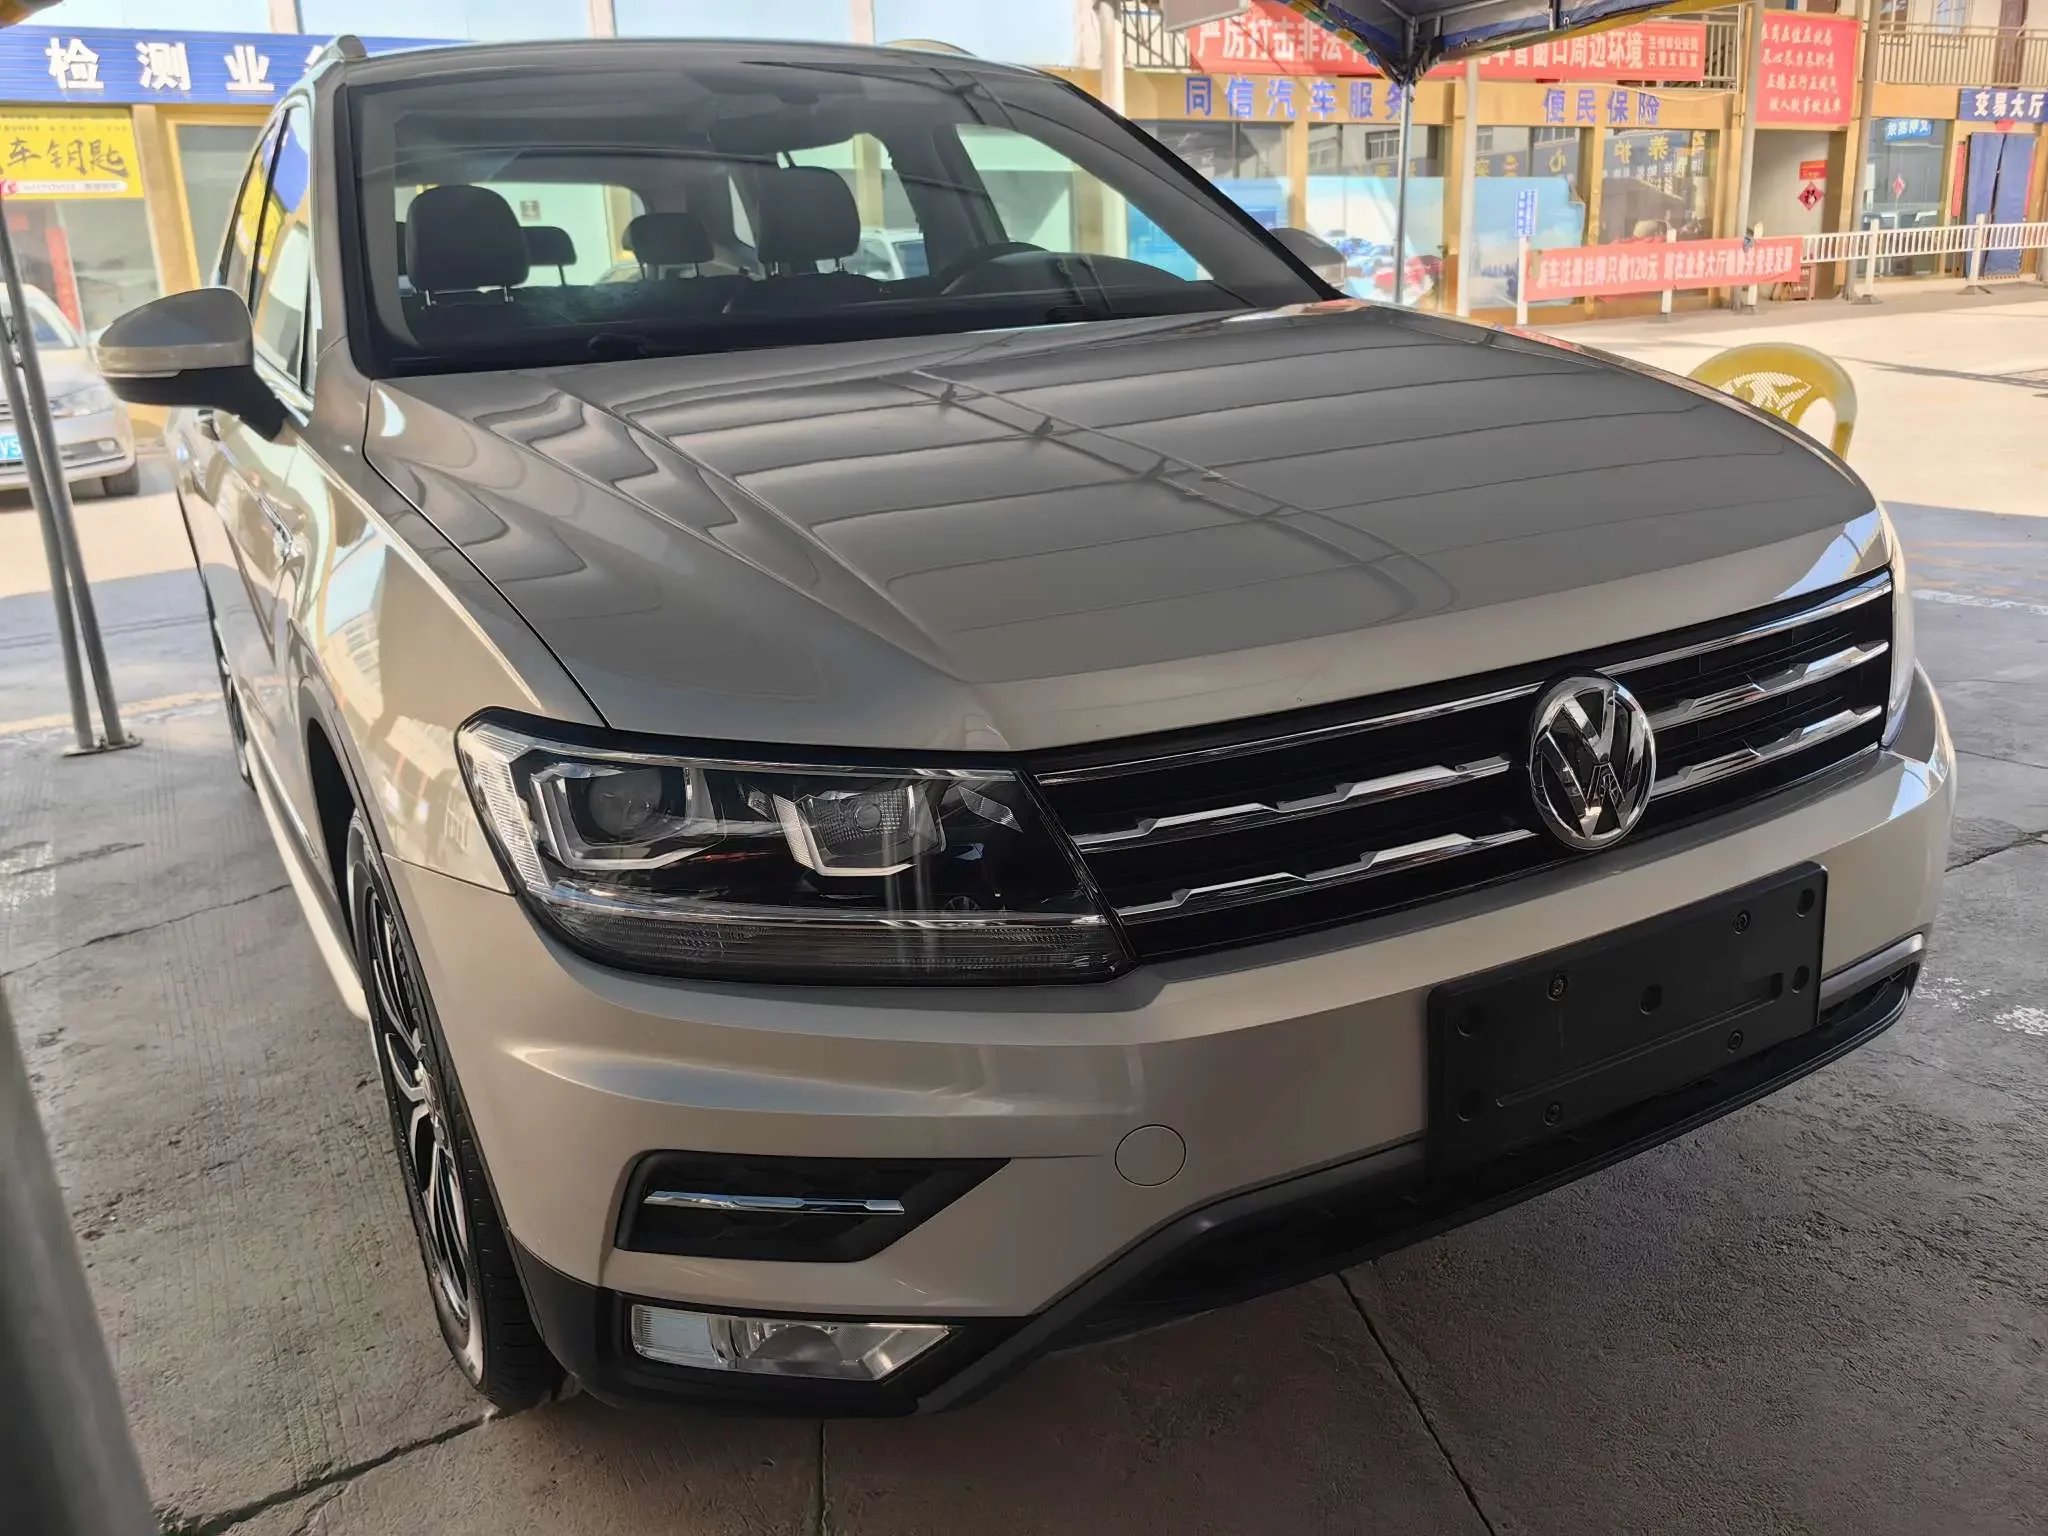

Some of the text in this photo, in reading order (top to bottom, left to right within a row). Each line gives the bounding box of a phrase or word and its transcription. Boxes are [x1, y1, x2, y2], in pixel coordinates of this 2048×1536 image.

[1198, 14, 1361, 63] 严厉打击非法
[1478, 31, 1643, 70] 管窗口周边环境
[1184, 75, 1402, 120] 同信汽车服务
[1543, 87, 1661, 125] 便民保险
[1973, 91, 2046, 120] 交易大厅
[0, 136, 130, 178] 车钥匙
